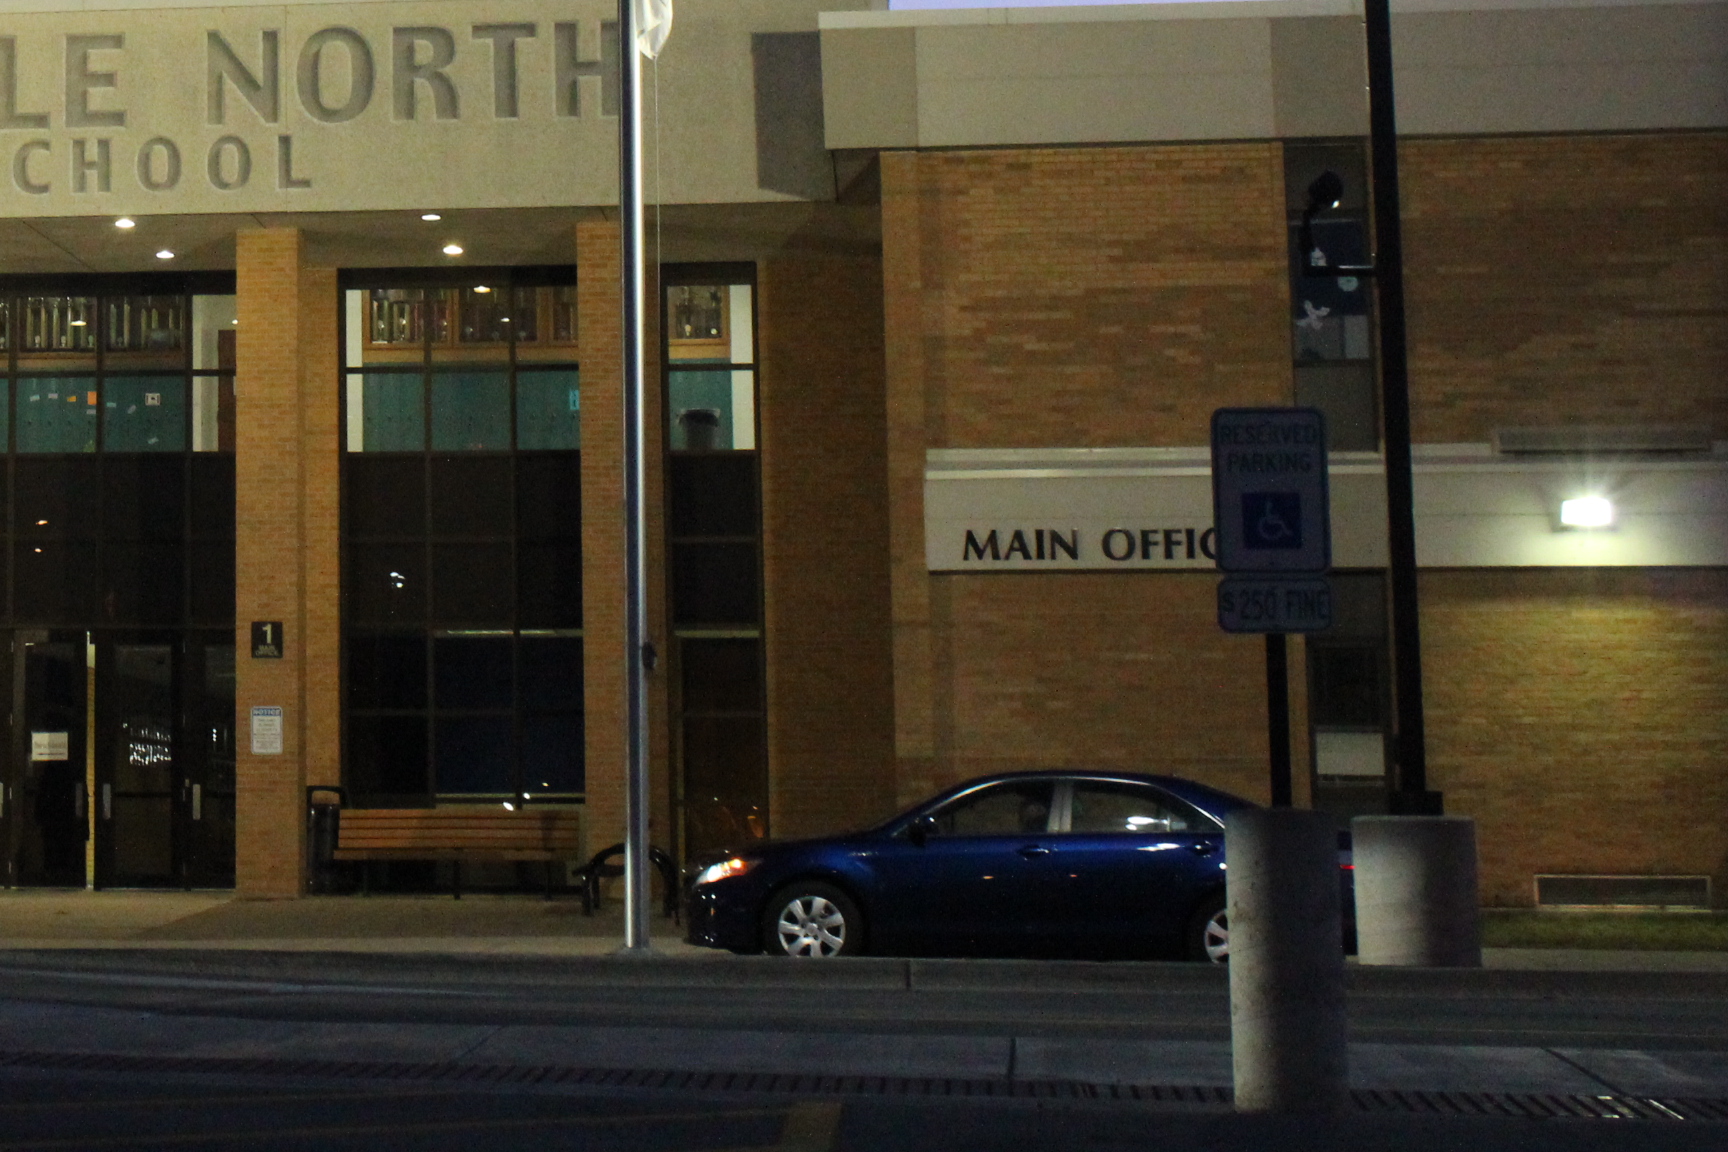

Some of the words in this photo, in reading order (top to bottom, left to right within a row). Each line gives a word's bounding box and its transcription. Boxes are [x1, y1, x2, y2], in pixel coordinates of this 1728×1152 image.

[205, 19, 619, 126] NORTH
[1220, 424, 1317, 445] RESERVED
[1227, 452, 1310, 473] PARKING
[962, 528, 1079, 562] MAIN
[1100, 527, 1216, 562] OFFIC
[1286, 589, 1329, 620] FINE
[262, 623, 272, 644] 1
